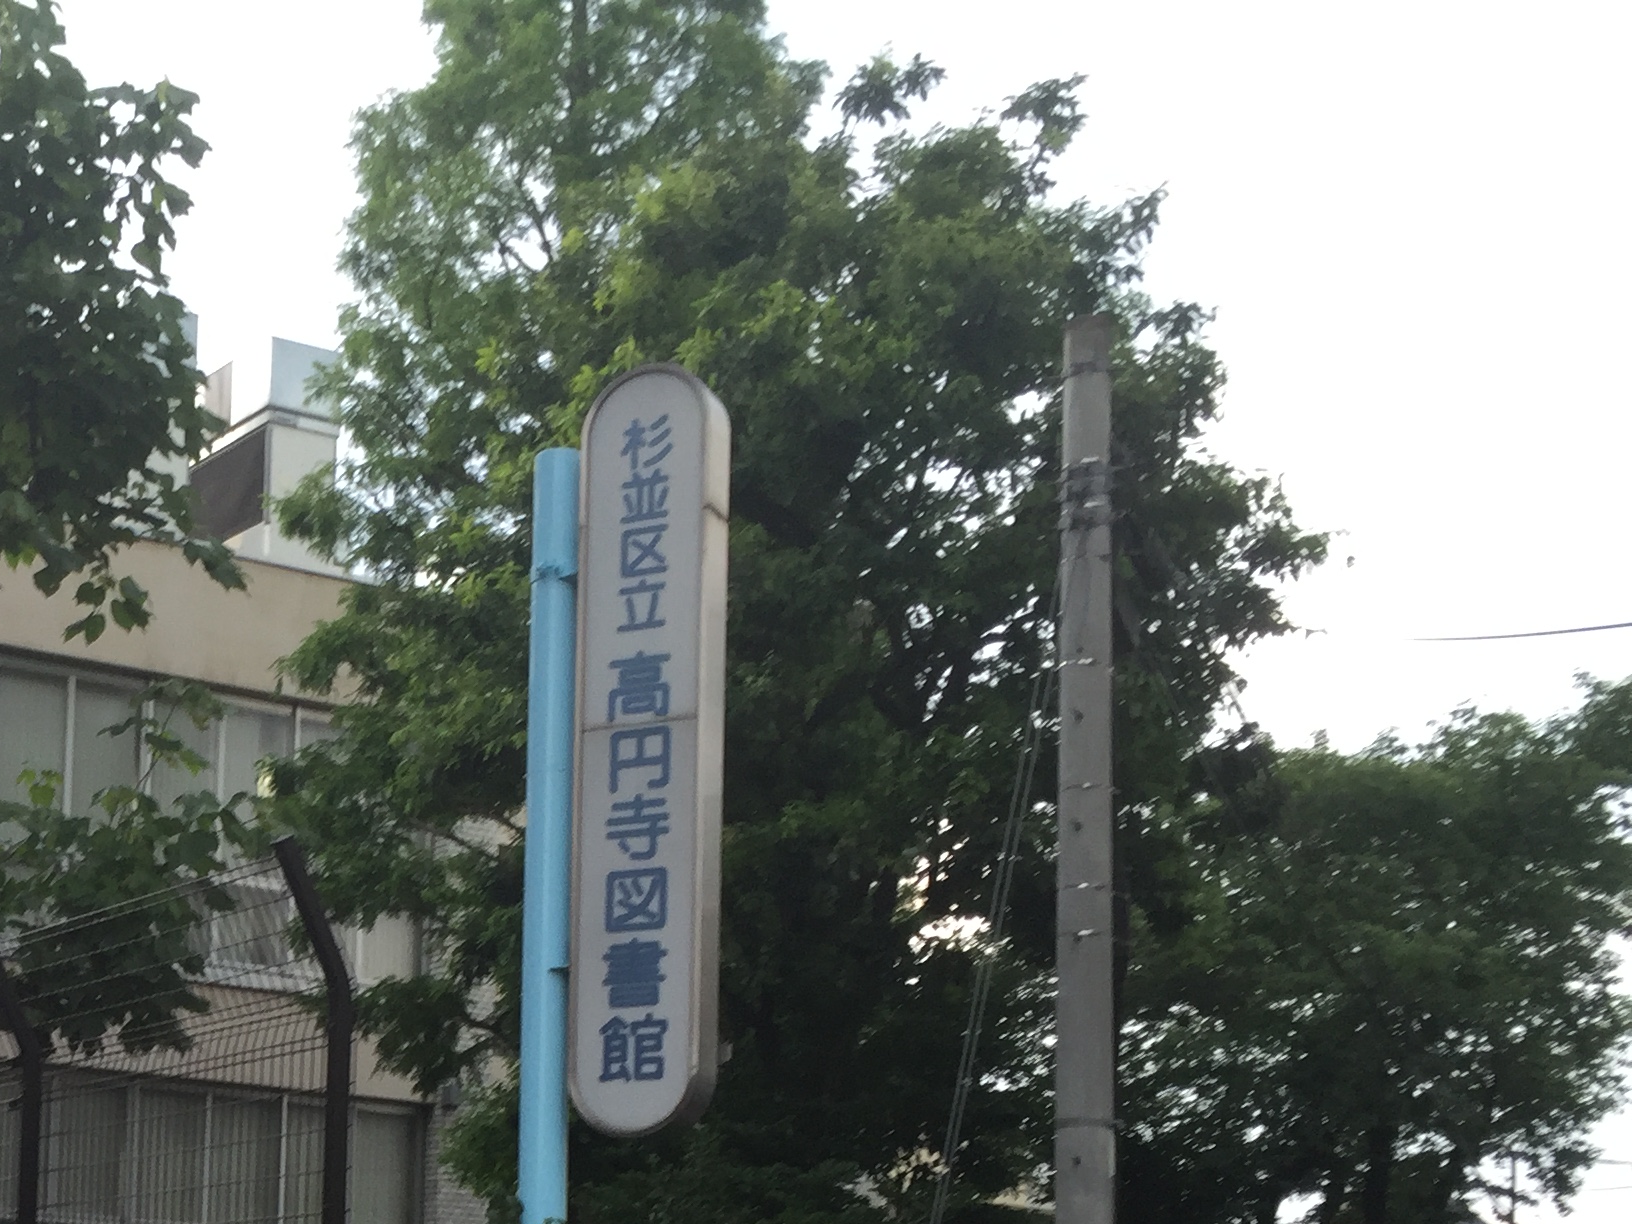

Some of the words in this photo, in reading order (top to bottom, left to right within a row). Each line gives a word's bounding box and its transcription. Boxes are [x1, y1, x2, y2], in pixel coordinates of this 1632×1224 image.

[598, 412, 674, 1085] 杉並区立高円寺図書館
